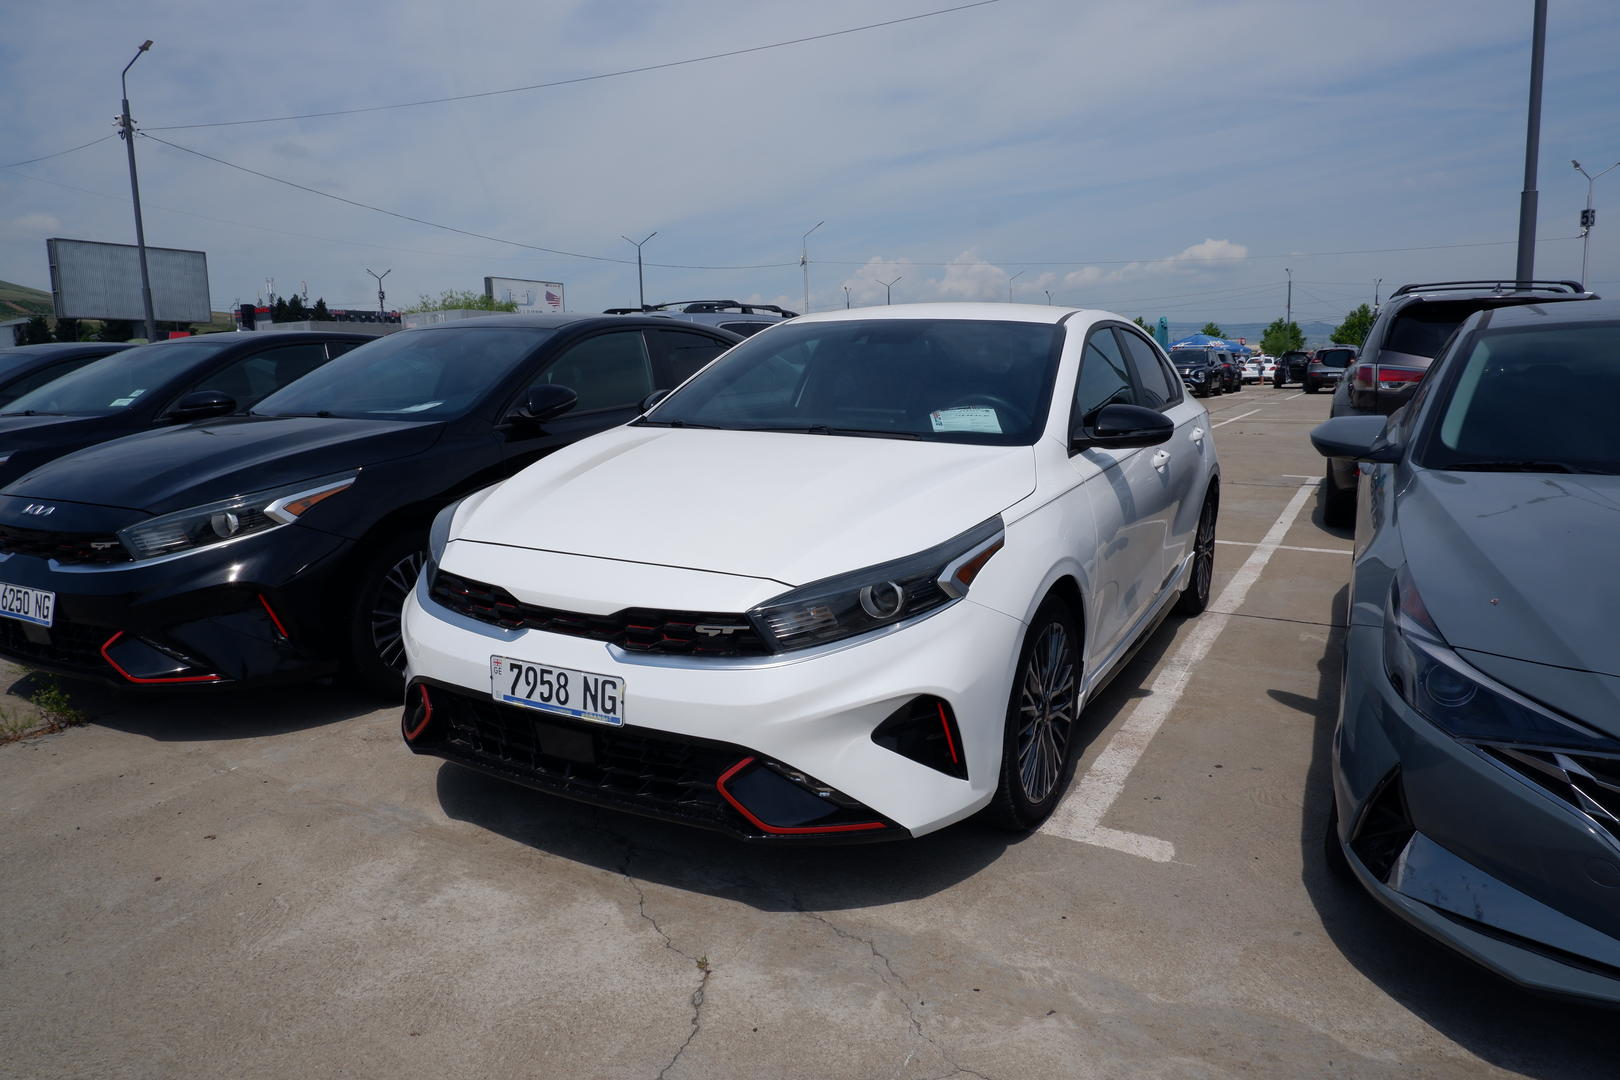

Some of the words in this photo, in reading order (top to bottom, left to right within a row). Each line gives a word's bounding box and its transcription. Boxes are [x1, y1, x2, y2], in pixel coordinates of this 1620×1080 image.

[1, 586, 30, 615] 6250
[34, 593, 51, 620] NG
[694, 624, 752, 637] GT
[509, 662, 570, 706] 7958
[582, 675, 617, 716] NG
